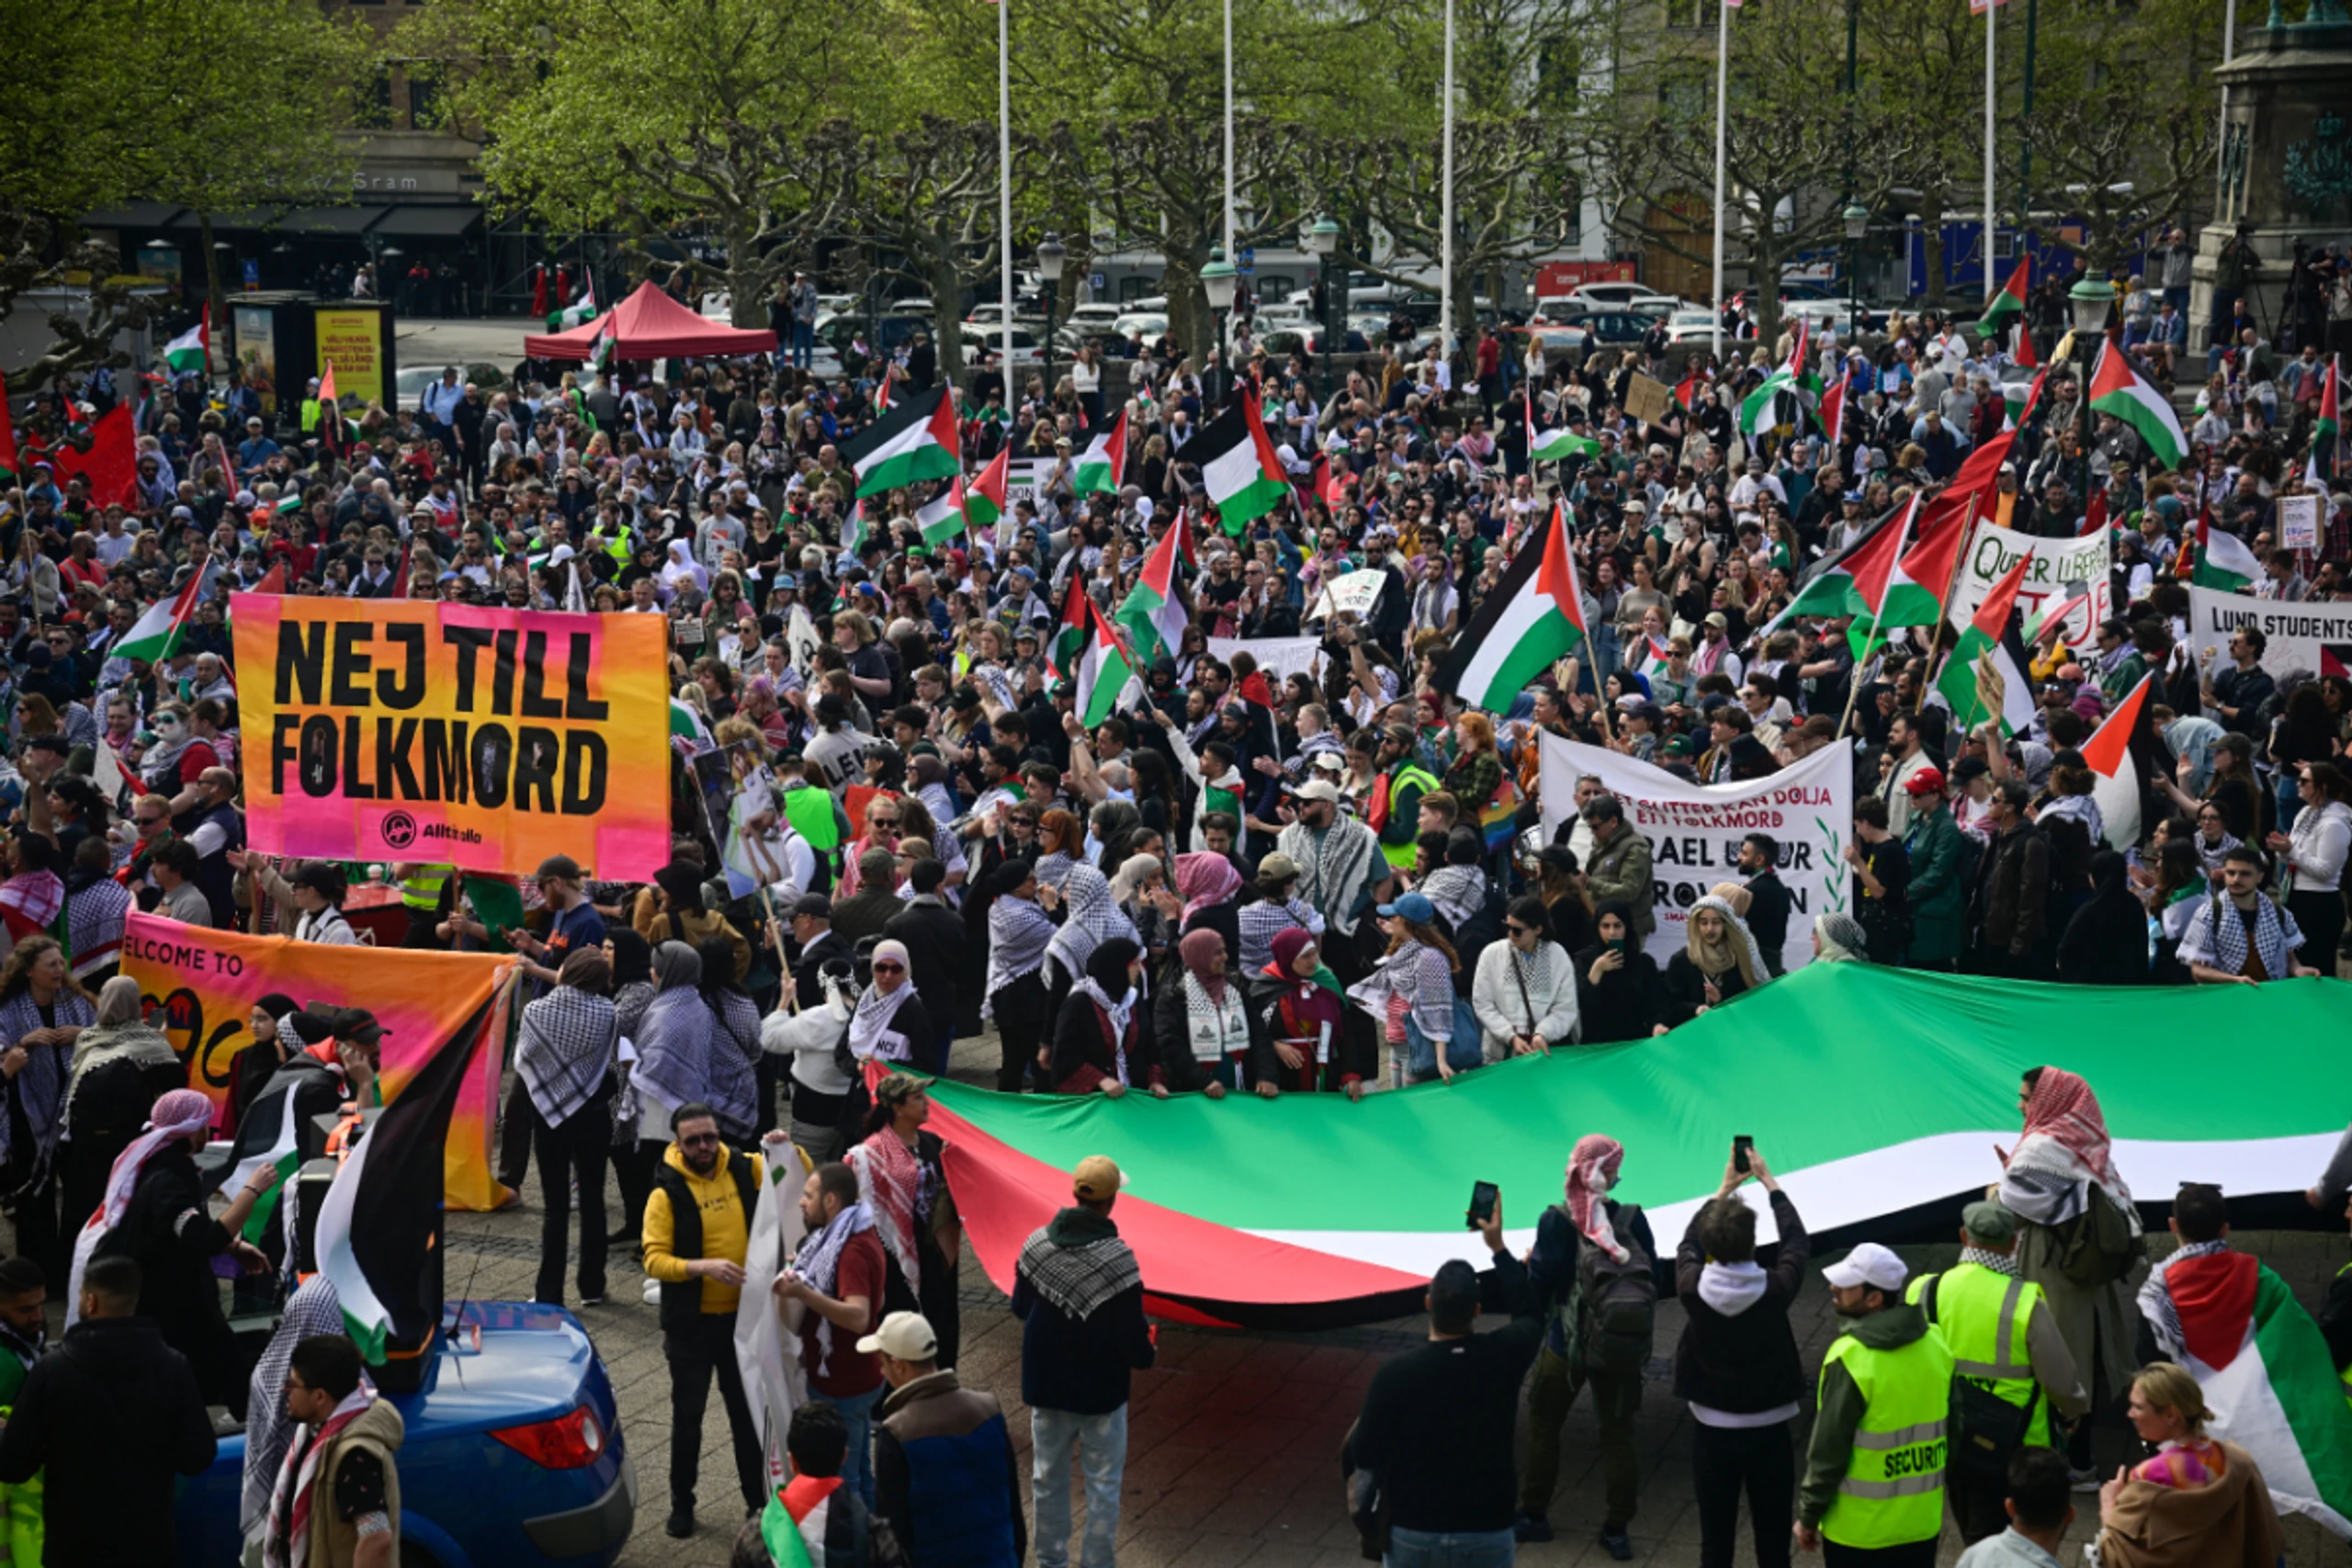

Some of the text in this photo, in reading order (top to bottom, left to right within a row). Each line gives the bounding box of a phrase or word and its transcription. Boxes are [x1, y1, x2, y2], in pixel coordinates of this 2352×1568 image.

[352, 172, 417, 189] Gram
[2211, 606, 2258, 633] LUND
[273, 620, 609, 721] NEJ TILL
[272, 713, 608, 816] FOLKMORD
[1721, 795, 1769, 810] KAN
[1773, 783, 1832, 807] DÖLJA
[1672, 810, 1784, 829] FOLKMORD
[124, 936, 243, 976] ELCOME TO
[1883, 1439, 1946, 1478] SECURIT
